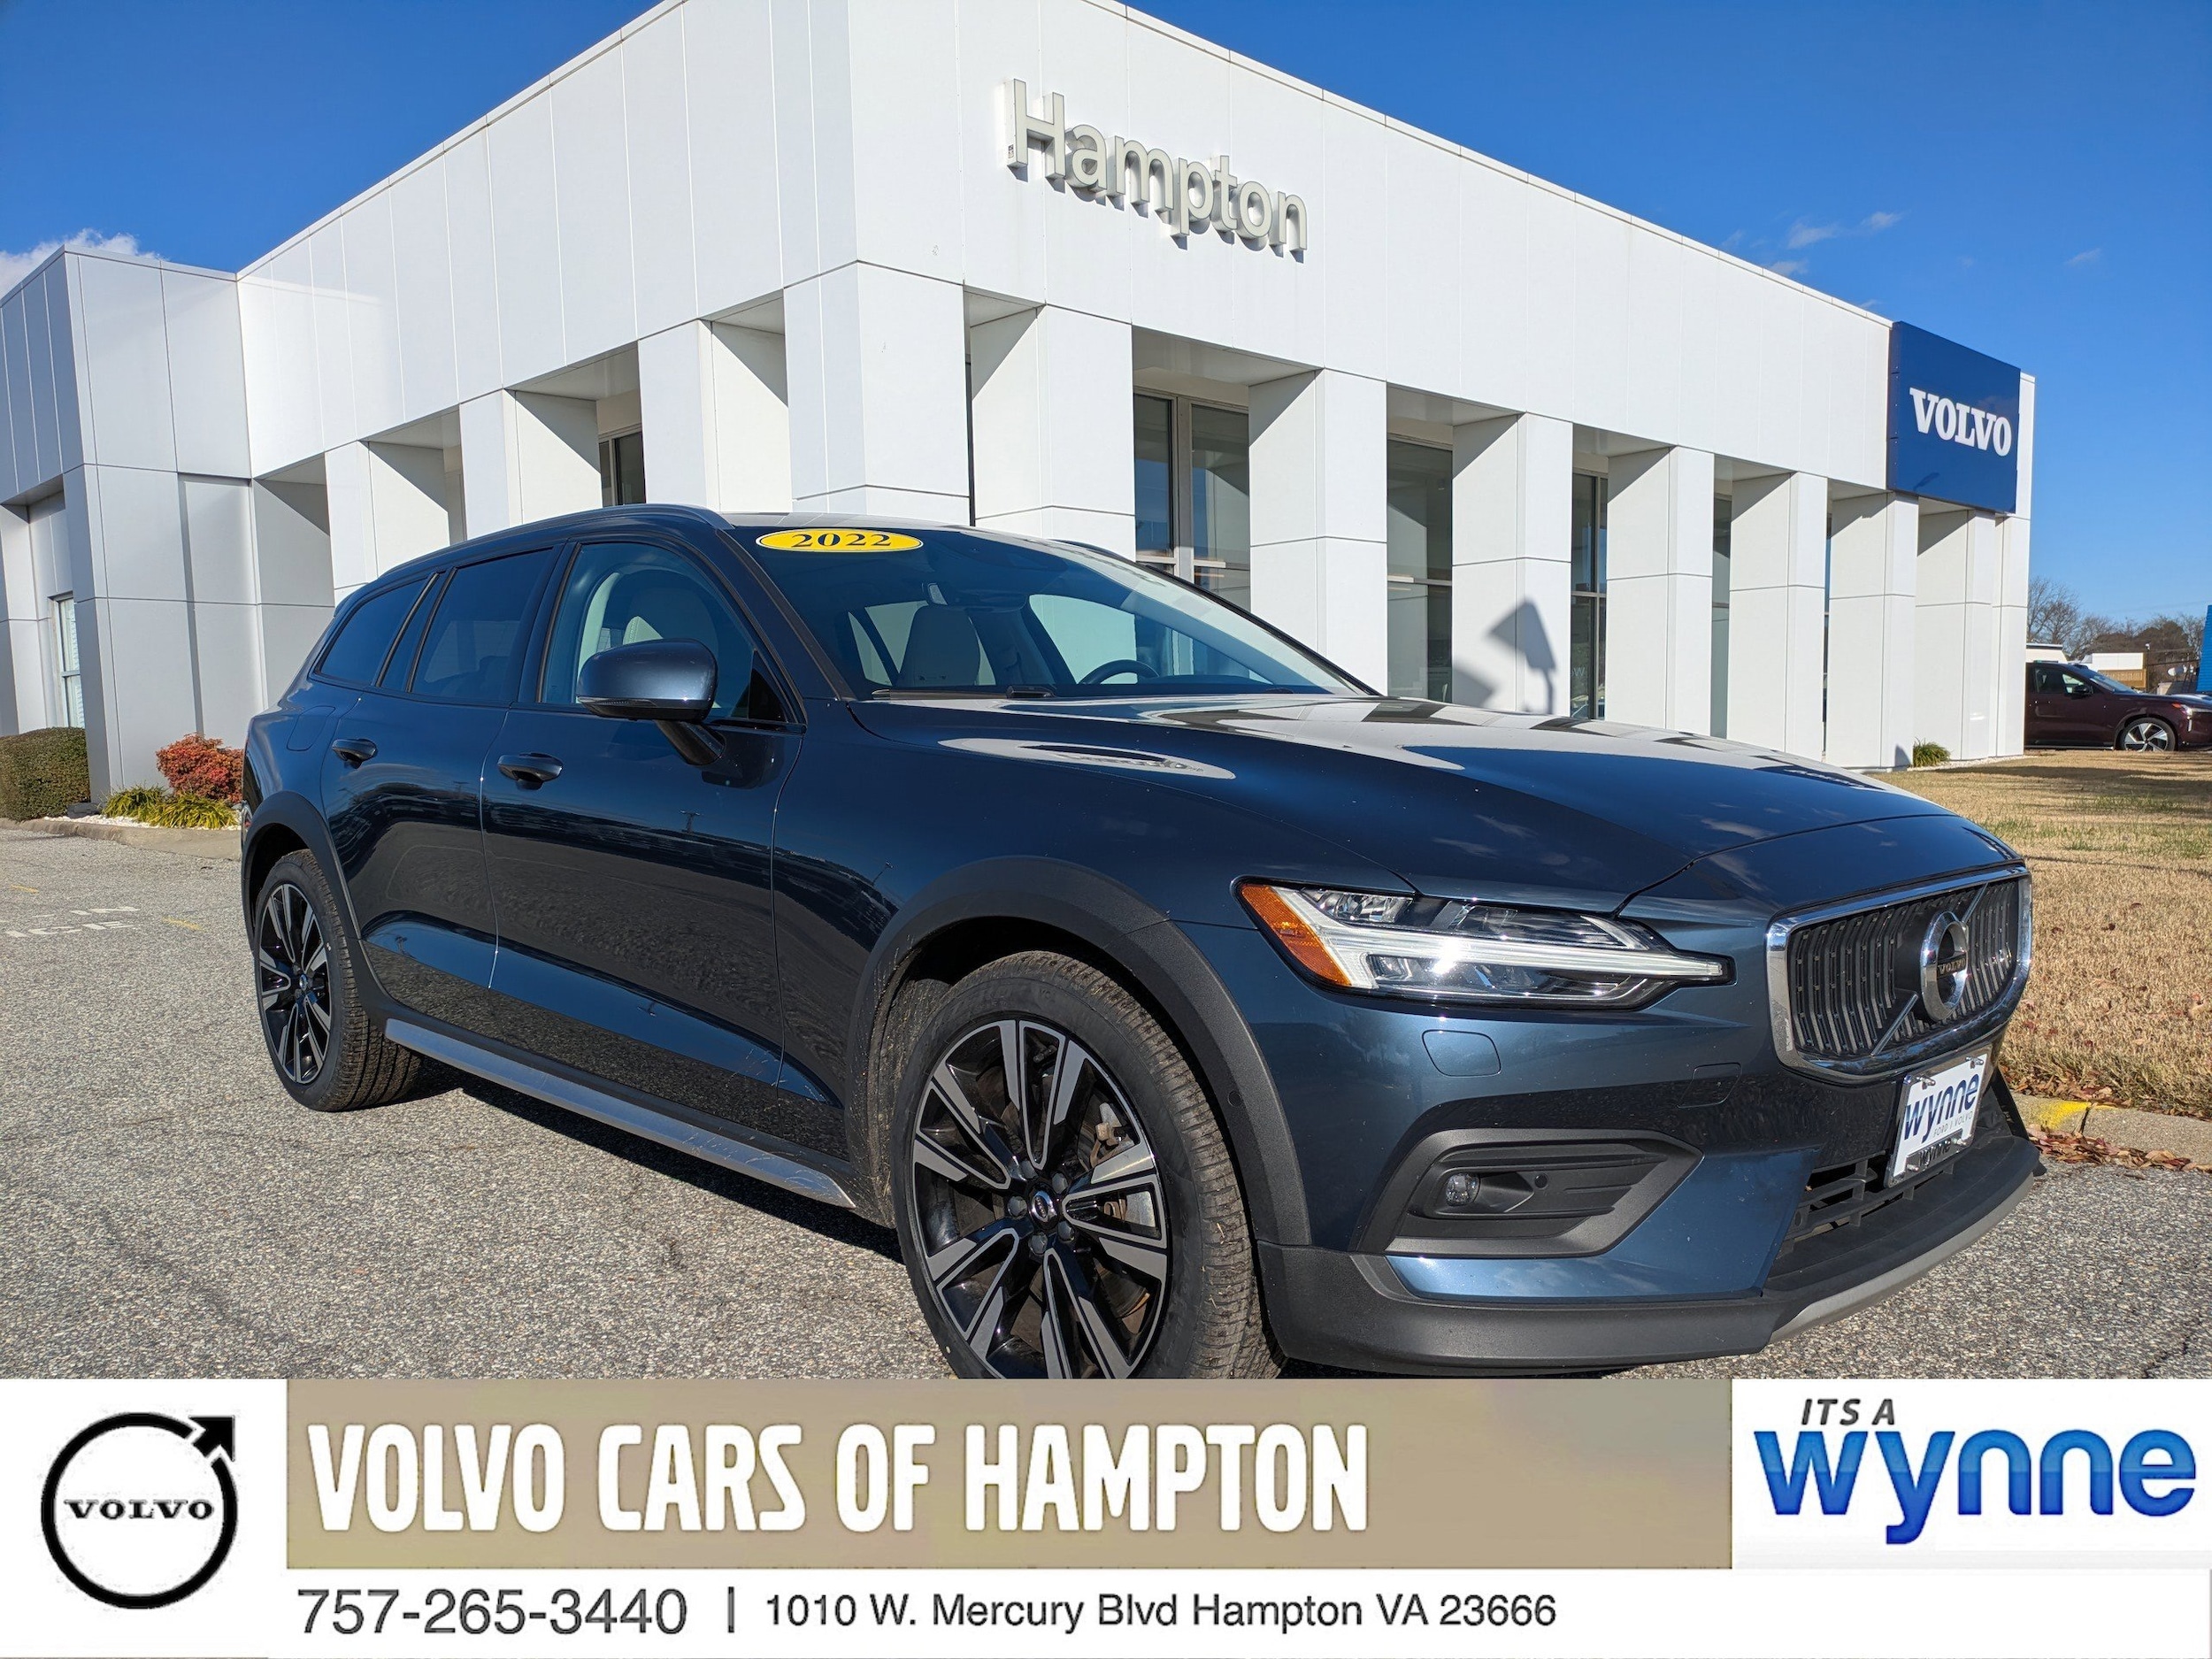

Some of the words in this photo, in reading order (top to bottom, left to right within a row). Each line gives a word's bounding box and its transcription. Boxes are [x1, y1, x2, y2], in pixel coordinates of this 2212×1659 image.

[1007, 78, 1309, 257] Hampton
[1909, 387, 2012, 457] VOLVO
[791, 533, 892, 548] 2022
[1904, 1073, 1979, 1143] wynne
[1932, 1123, 1948, 1138] FORD
[1955, 1110, 1973, 1126] VOLVO
